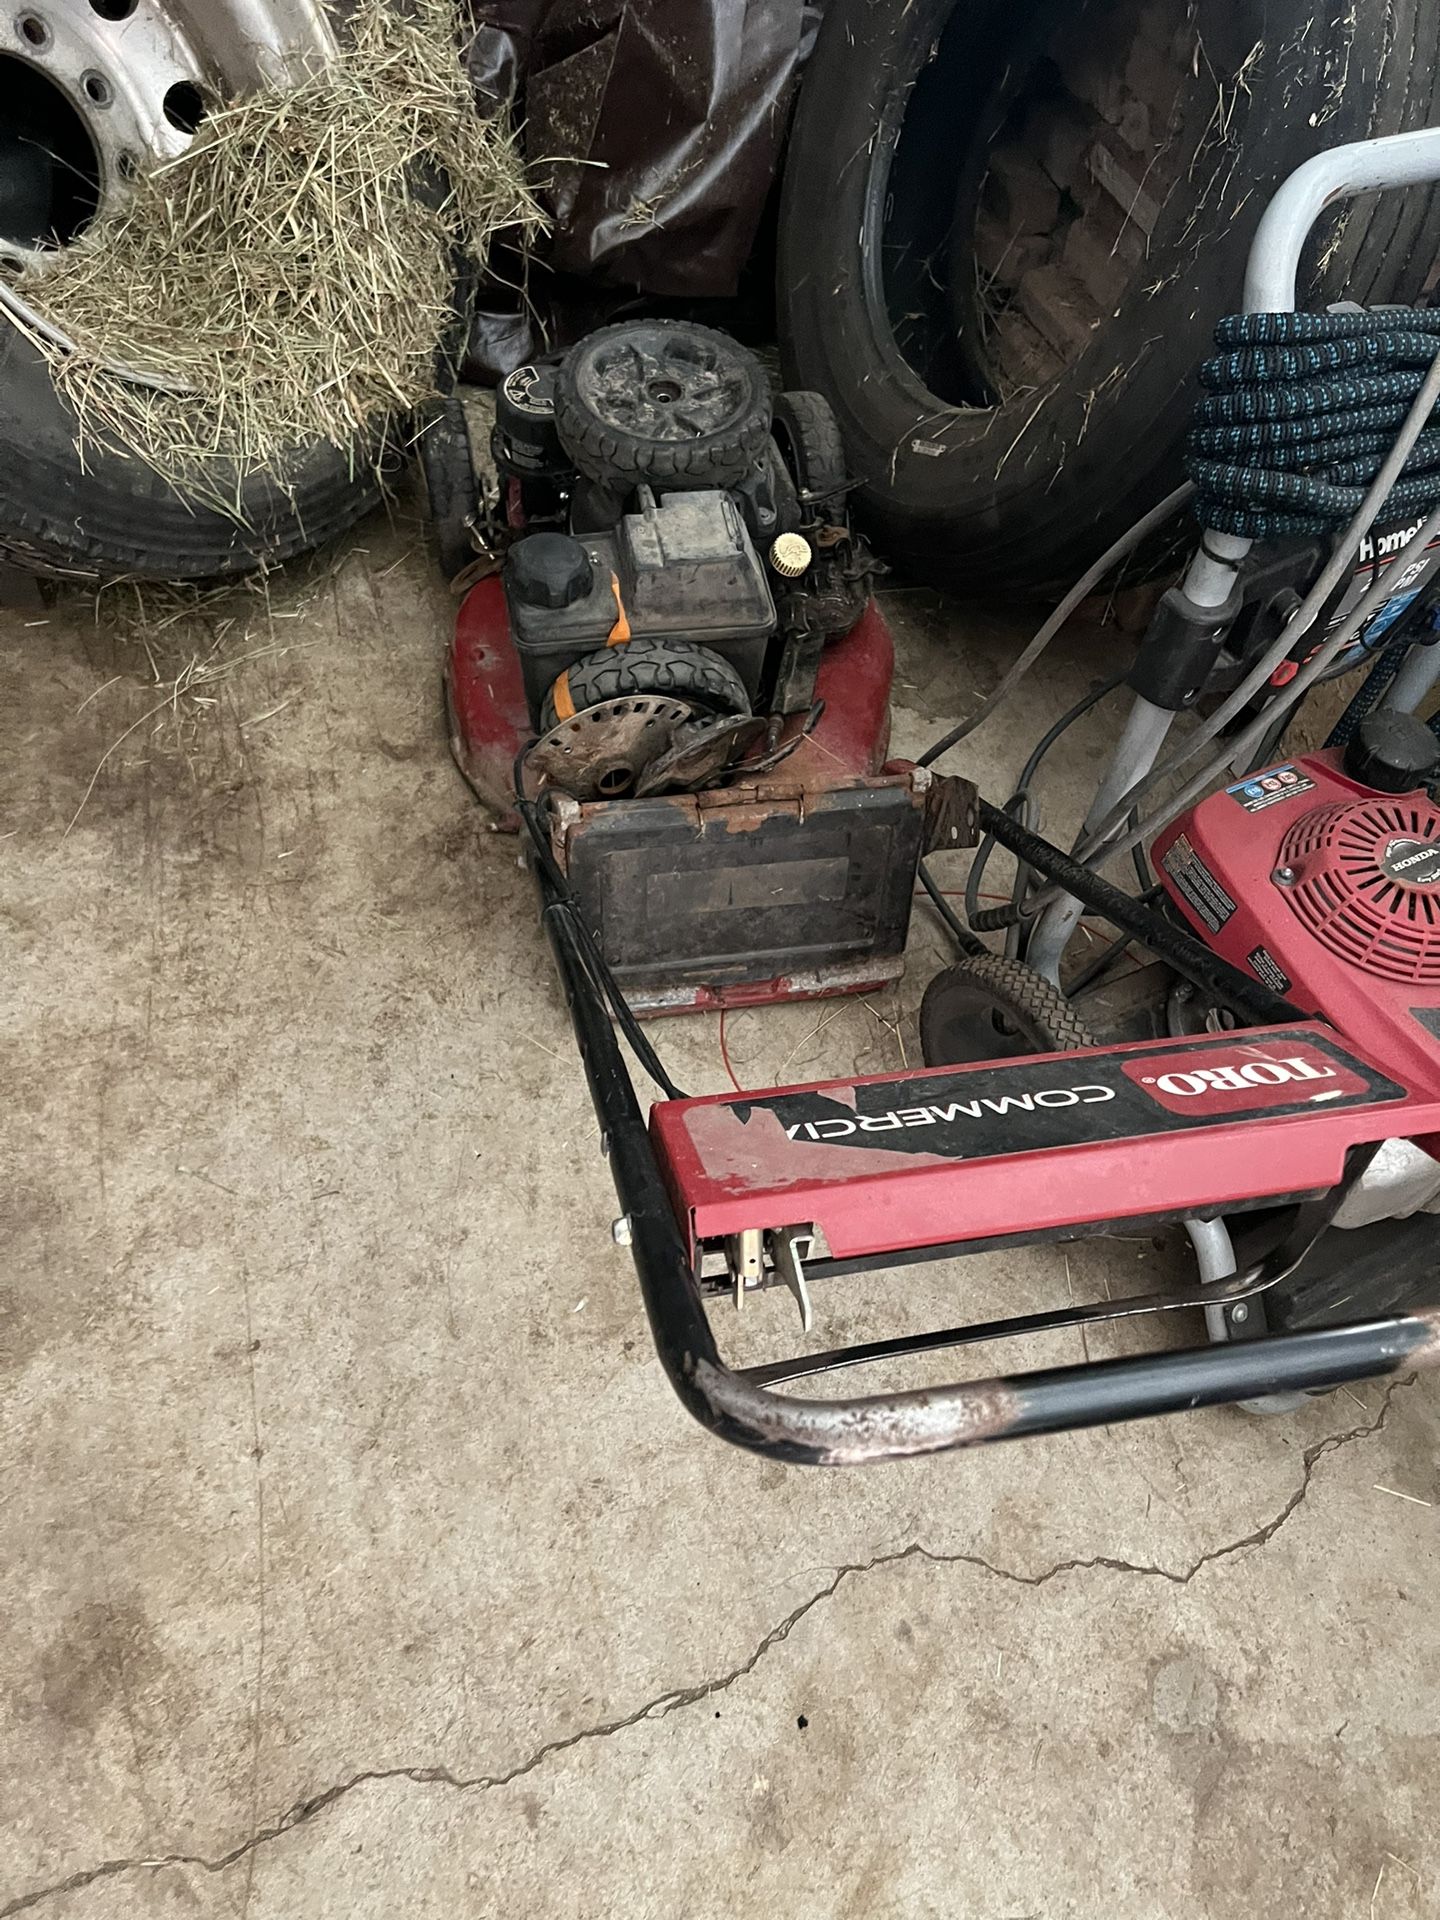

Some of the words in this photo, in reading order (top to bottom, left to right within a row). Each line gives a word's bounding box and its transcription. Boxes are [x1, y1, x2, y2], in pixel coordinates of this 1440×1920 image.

[1401, 558, 1431, 578] PSI
[1390, 573, 1419, 591] PM
[1391, 848, 1439, 872] HONDA
